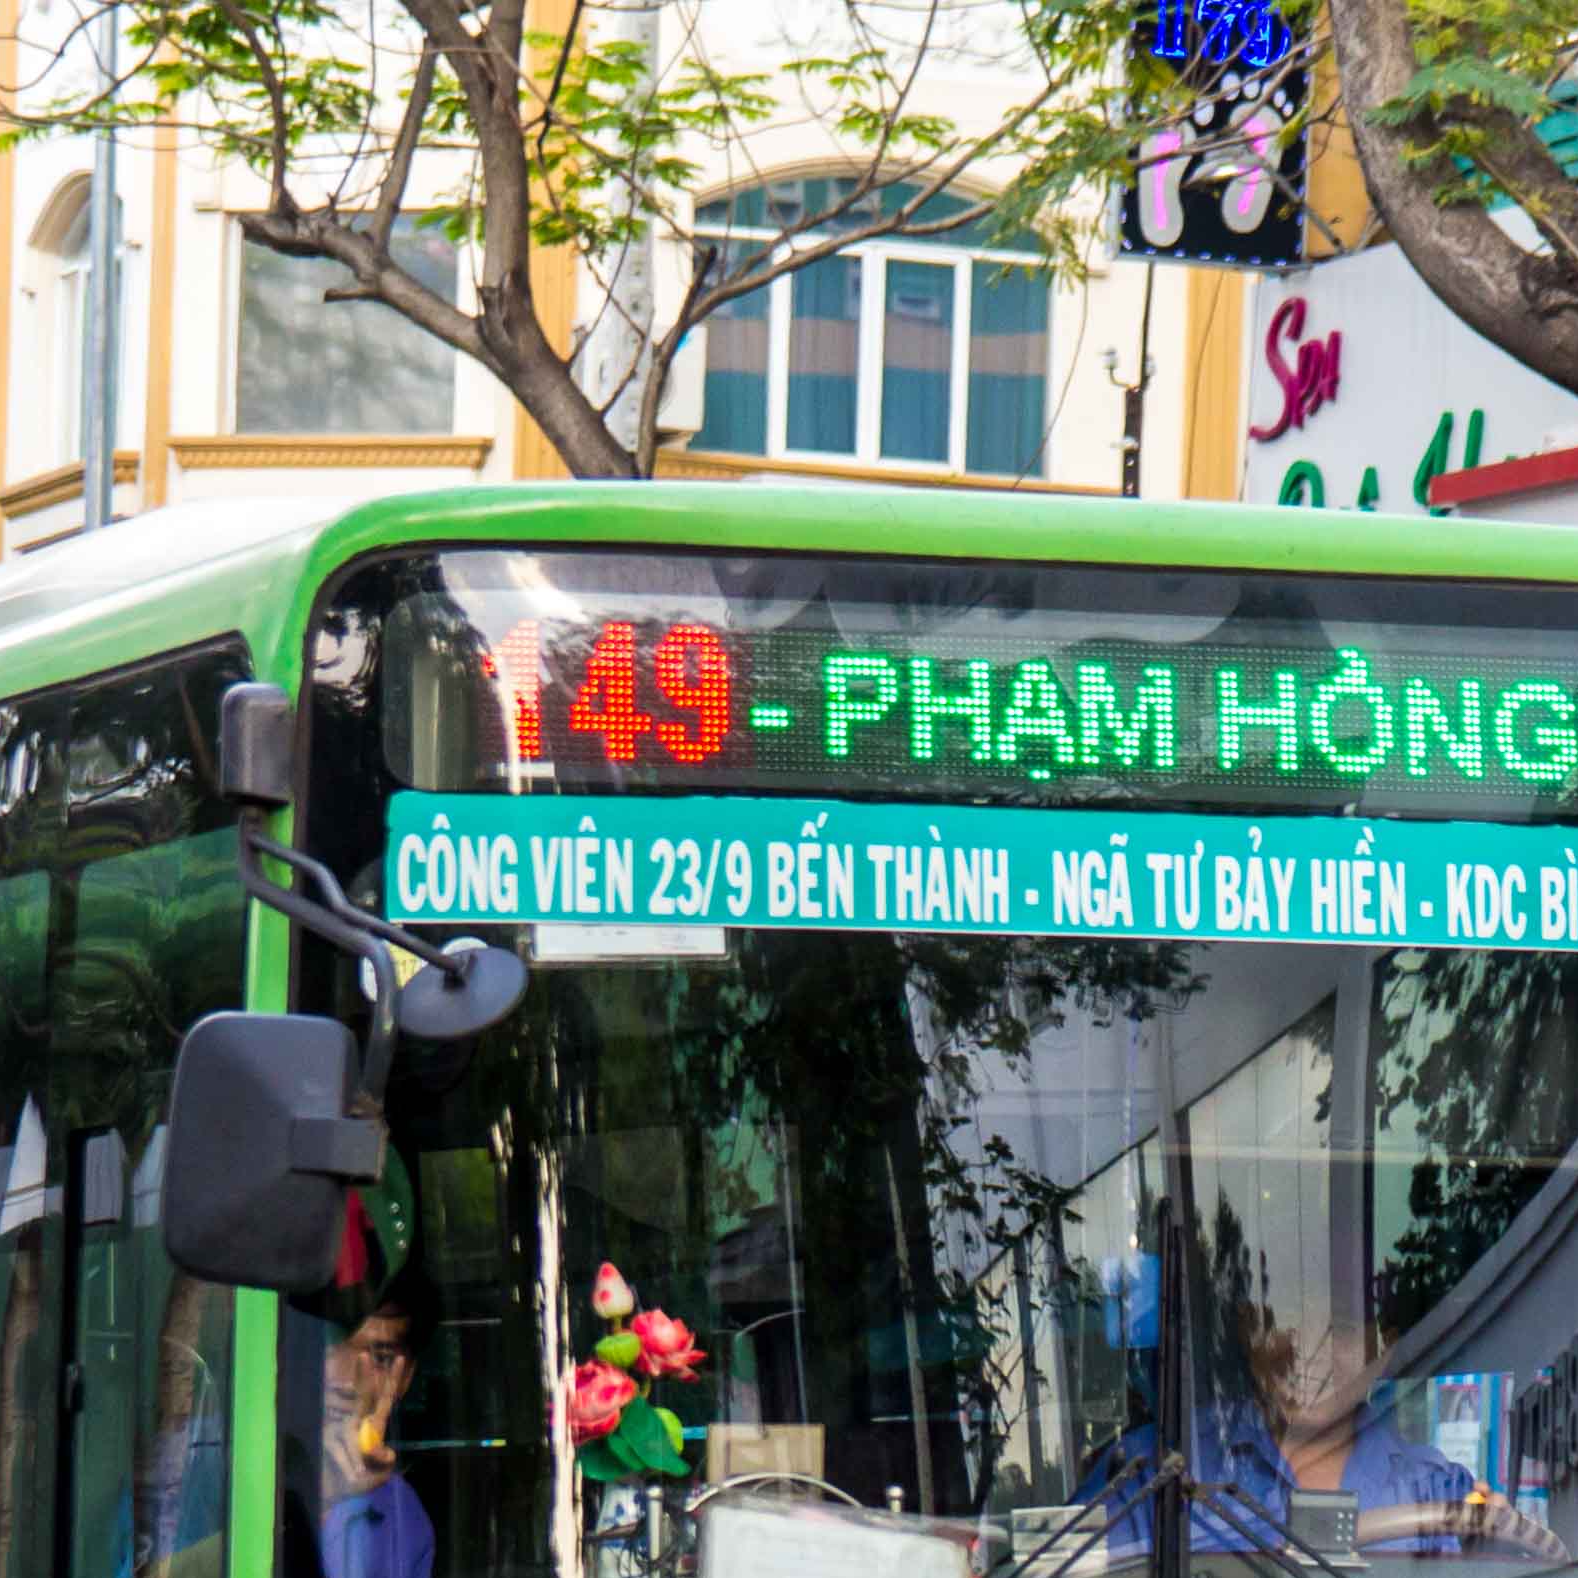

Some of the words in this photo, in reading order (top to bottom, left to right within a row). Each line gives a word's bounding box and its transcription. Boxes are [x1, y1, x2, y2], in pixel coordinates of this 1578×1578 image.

[481, 618, 732, 764] 149
[824, 649, 1176, 781] PHẠM
[1217, 646, 1578, 782] HỒNG
[396, 812, 520, 914] CÔNG
[532, 815, 634, 914] VIÊN
[649, 838, 753, 917] 23/9
[767, 811, 856, 919] BẾN
[866, 823, 1011, 923] THÀNH
[1052, 832, 1135, 929] NGÃ
[1146, 842, 1204, 931] TƯ
[1214, 825, 1296, 934] BẢY
[1311, 827, 1408, 936] HIỀN
[1445, 862, 1529, 941] KDC
